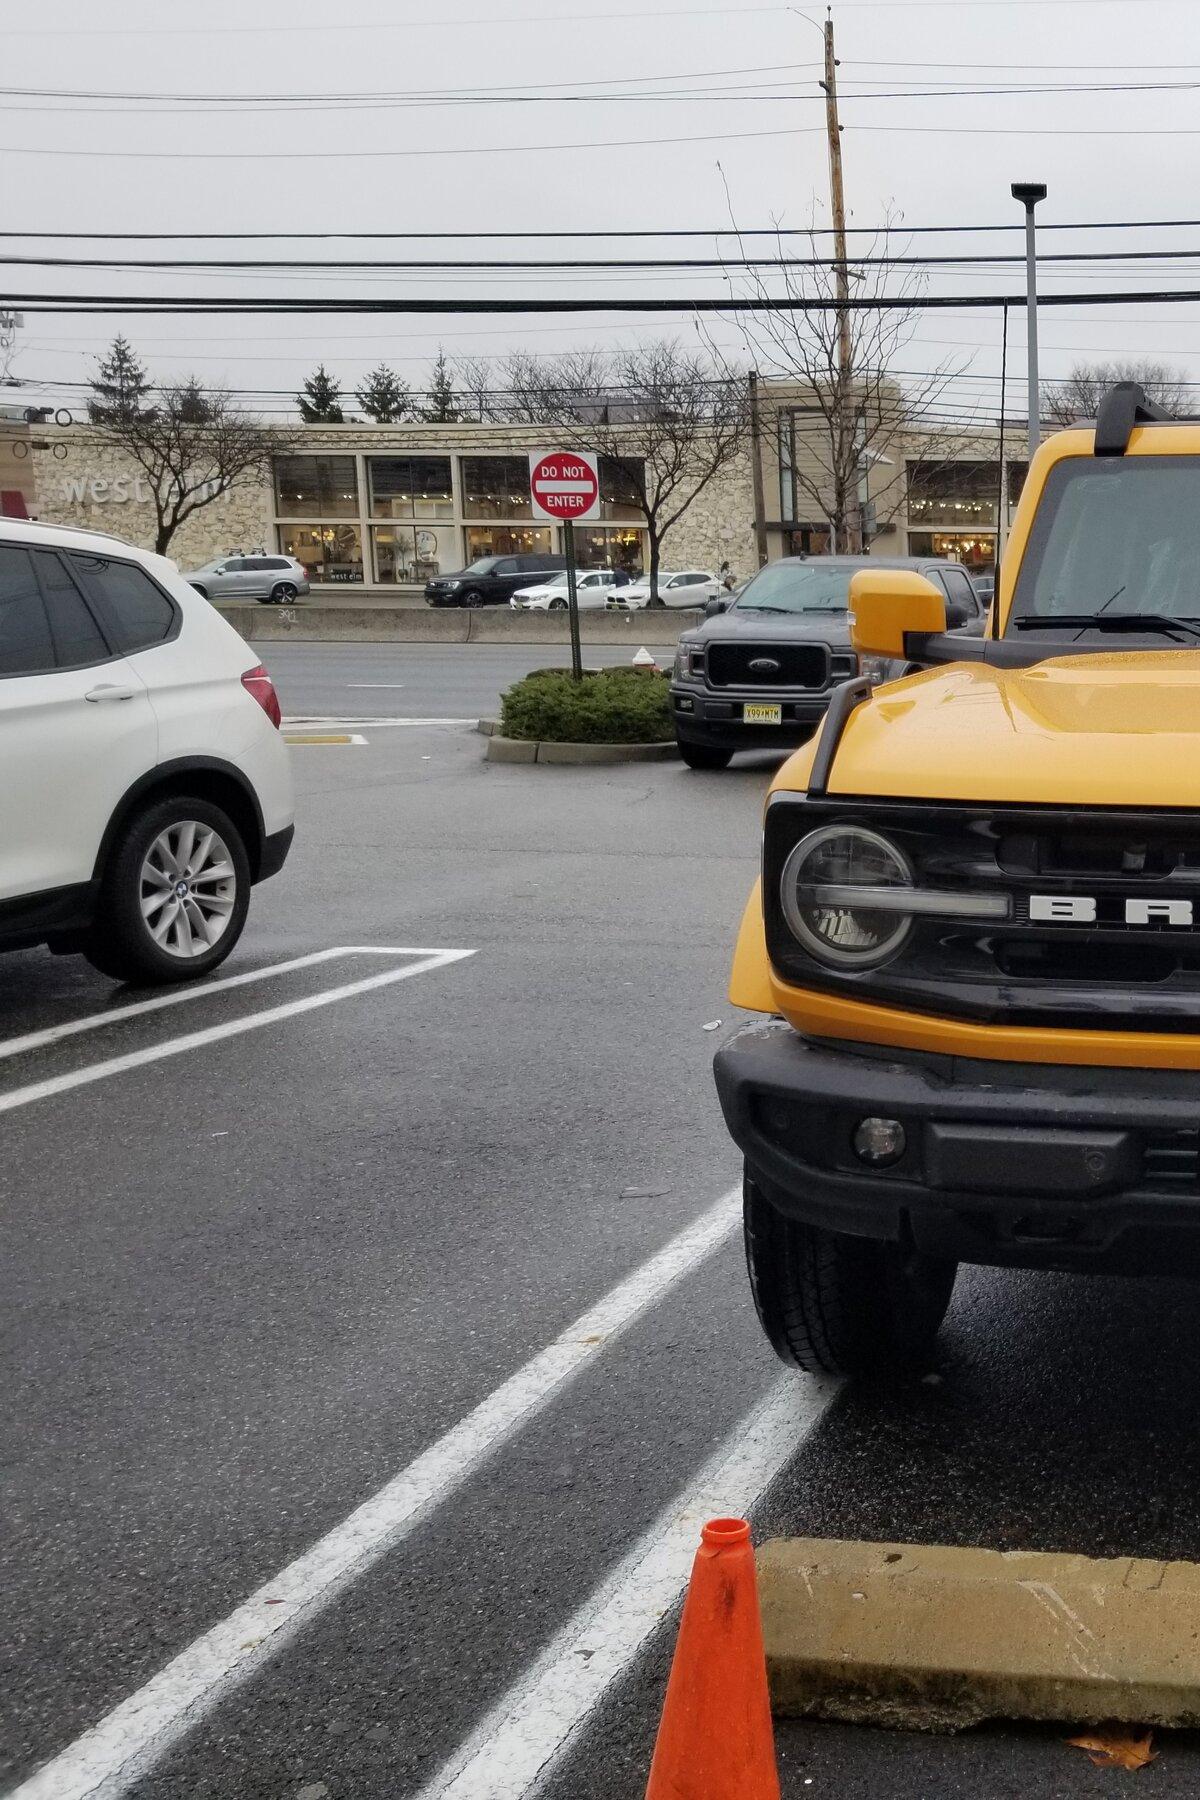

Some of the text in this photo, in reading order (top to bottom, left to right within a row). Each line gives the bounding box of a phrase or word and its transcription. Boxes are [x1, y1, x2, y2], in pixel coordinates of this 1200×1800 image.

[541, 466, 585, 478] DO NOT
[63, 474, 149, 503] west
[547, 495, 584, 507] ENTER
